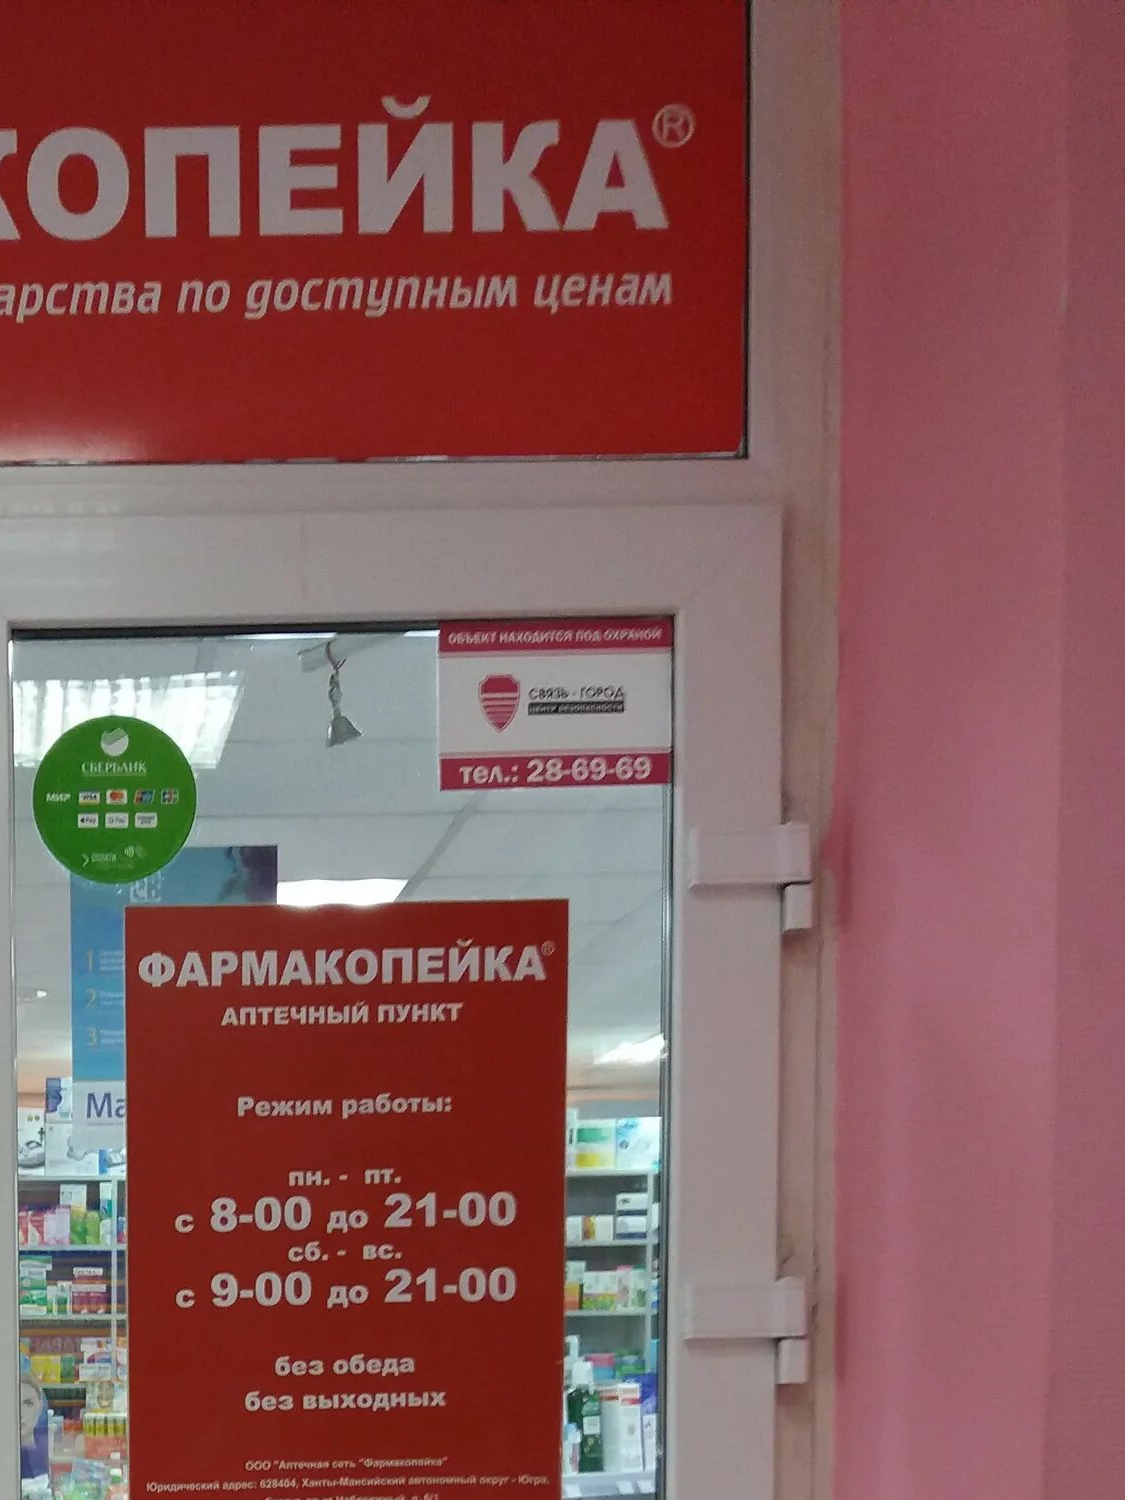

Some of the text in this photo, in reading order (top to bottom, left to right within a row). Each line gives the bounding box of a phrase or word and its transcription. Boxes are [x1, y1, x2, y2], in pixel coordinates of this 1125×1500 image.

[177, 277, 230, 313] по
[244, 272, 518, 320] доступным
[533, 270, 673, 314] ценам
[448, 626, 663, 645] ОБЪЕКТ НАХОДИТСЯ ПОД ОХРАНОЙ
[579, 684, 625, 700] ГОРОД
[81, 760, 148, 774] СБЕРБАНК
[459, 756, 653, 785] тел.: 28-69-69
[138, 938, 547, 988] ФАРМАКОПЕЙКА
[221, 1000, 463, 1026] АПТЕЧНЫЙ ПУНКТ
[237, 1092, 453, 1119] Режим работы:
[288, 1169, 330, 1187] пн.
[364, 1167, 402, 1185] пт.
[174, 1191, 518, 1234] с 8-00 до 21-00
[287, 1240, 329, 1262] сб.
[362, 1243, 403, 1261] вс.
[175, 1266, 518, 1309] с 9-00 до 21-00
[275, 1354, 416, 1377] без обеда
[244, 1390, 448, 1412] без выходных
[245, 1460, 272, 1472] ООО
[331, 1459, 356, 1470] сеть
[146, 1480, 220, 1494] Юридический
[222, 1480, 258, 1493] адрес:
[301, 1475, 407, 1490] Ханты-Мансийский
[408, 1475, 477, 1487] автономный
[479, 1475, 510, 1488] округ
